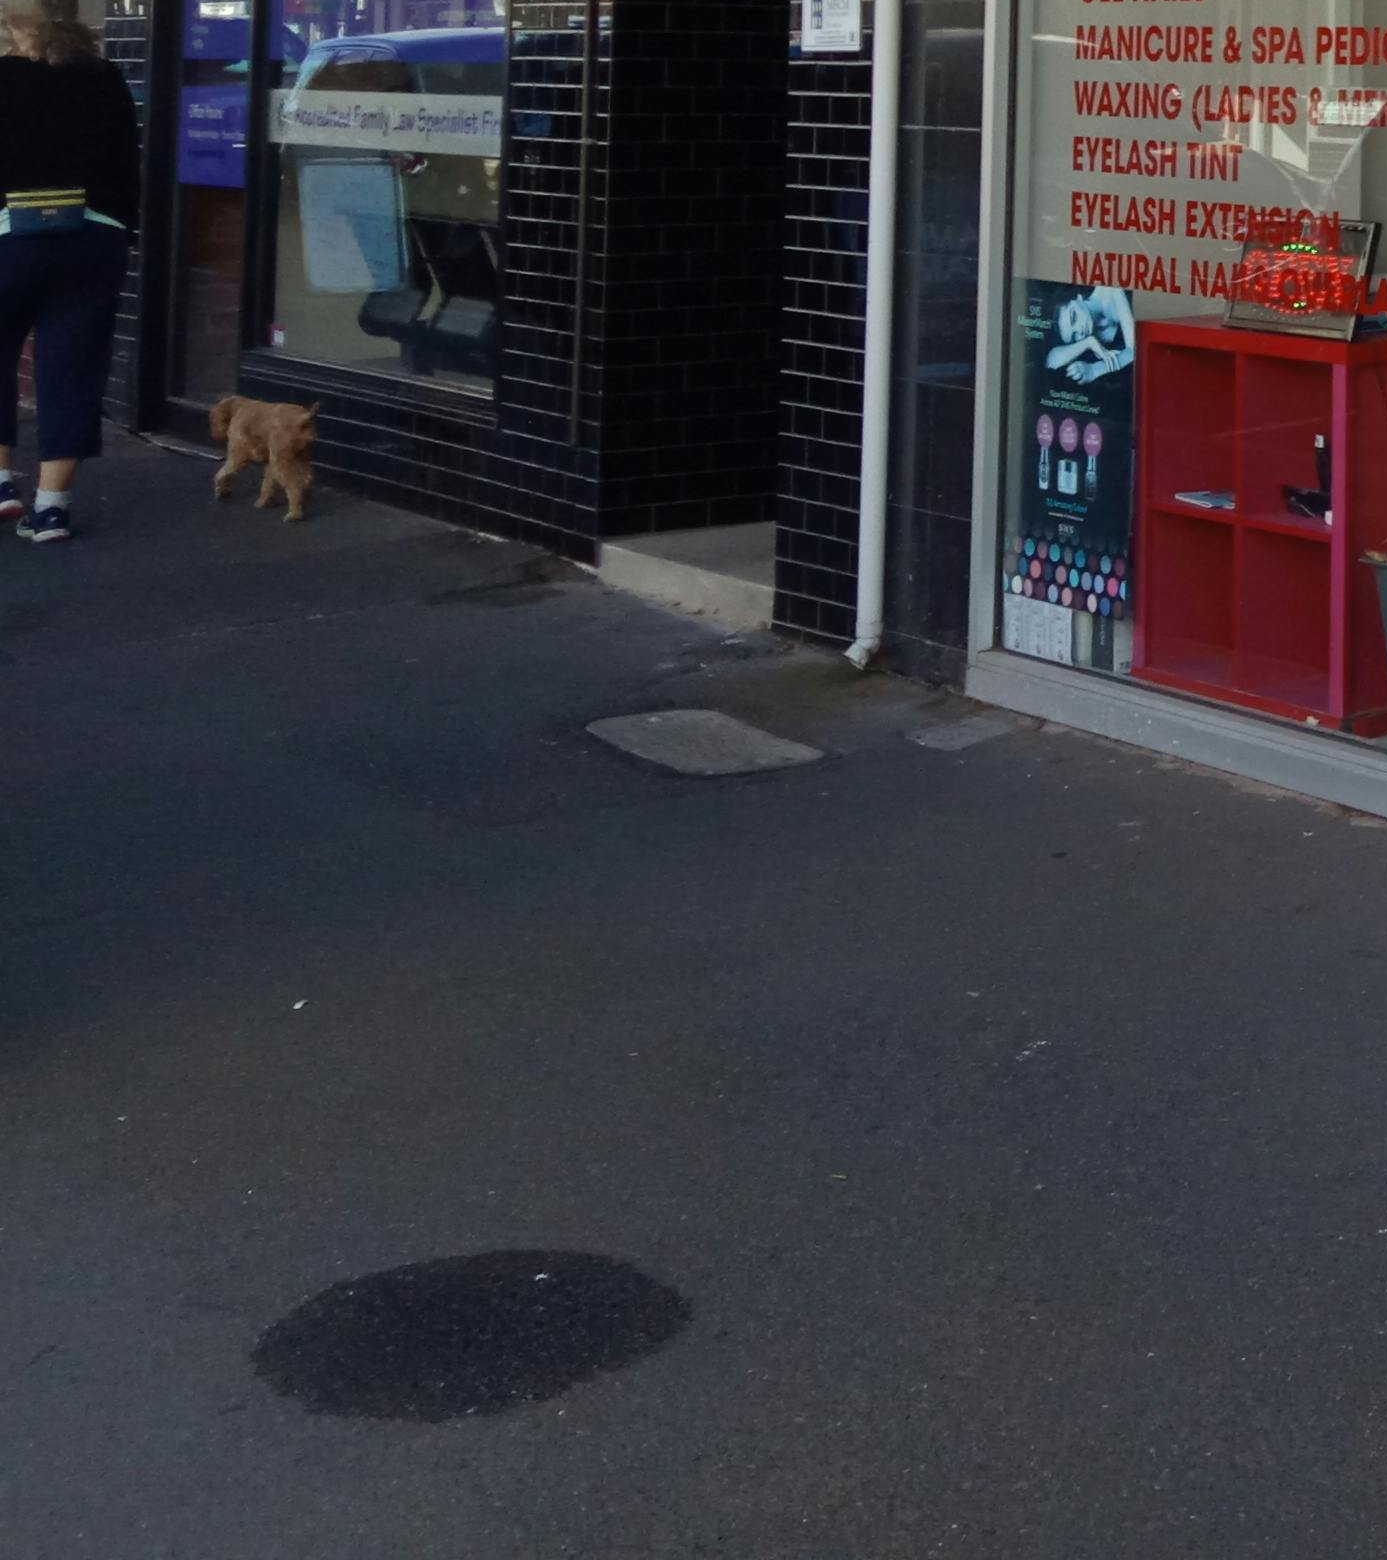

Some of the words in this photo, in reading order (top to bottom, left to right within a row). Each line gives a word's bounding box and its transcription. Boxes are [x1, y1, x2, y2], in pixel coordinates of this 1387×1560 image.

[1075, 24, 1214, 64] MANICURE
[1223, 24, 1242, 65] &
[1251, 26, 1306, 65] SPA
[1074, 81, 1183, 121] WAXING
[1191, 83, 1297, 132] (LADIES
[1072, 136, 1177, 178] EYELASH
[1187, 142, 1243, 182] TINT
[1071, 191, 1176, 236] EYELASH
[1185, 200, 1341, 251] EXTENSION
[1072, 250, 1182, 296] NATURAL
